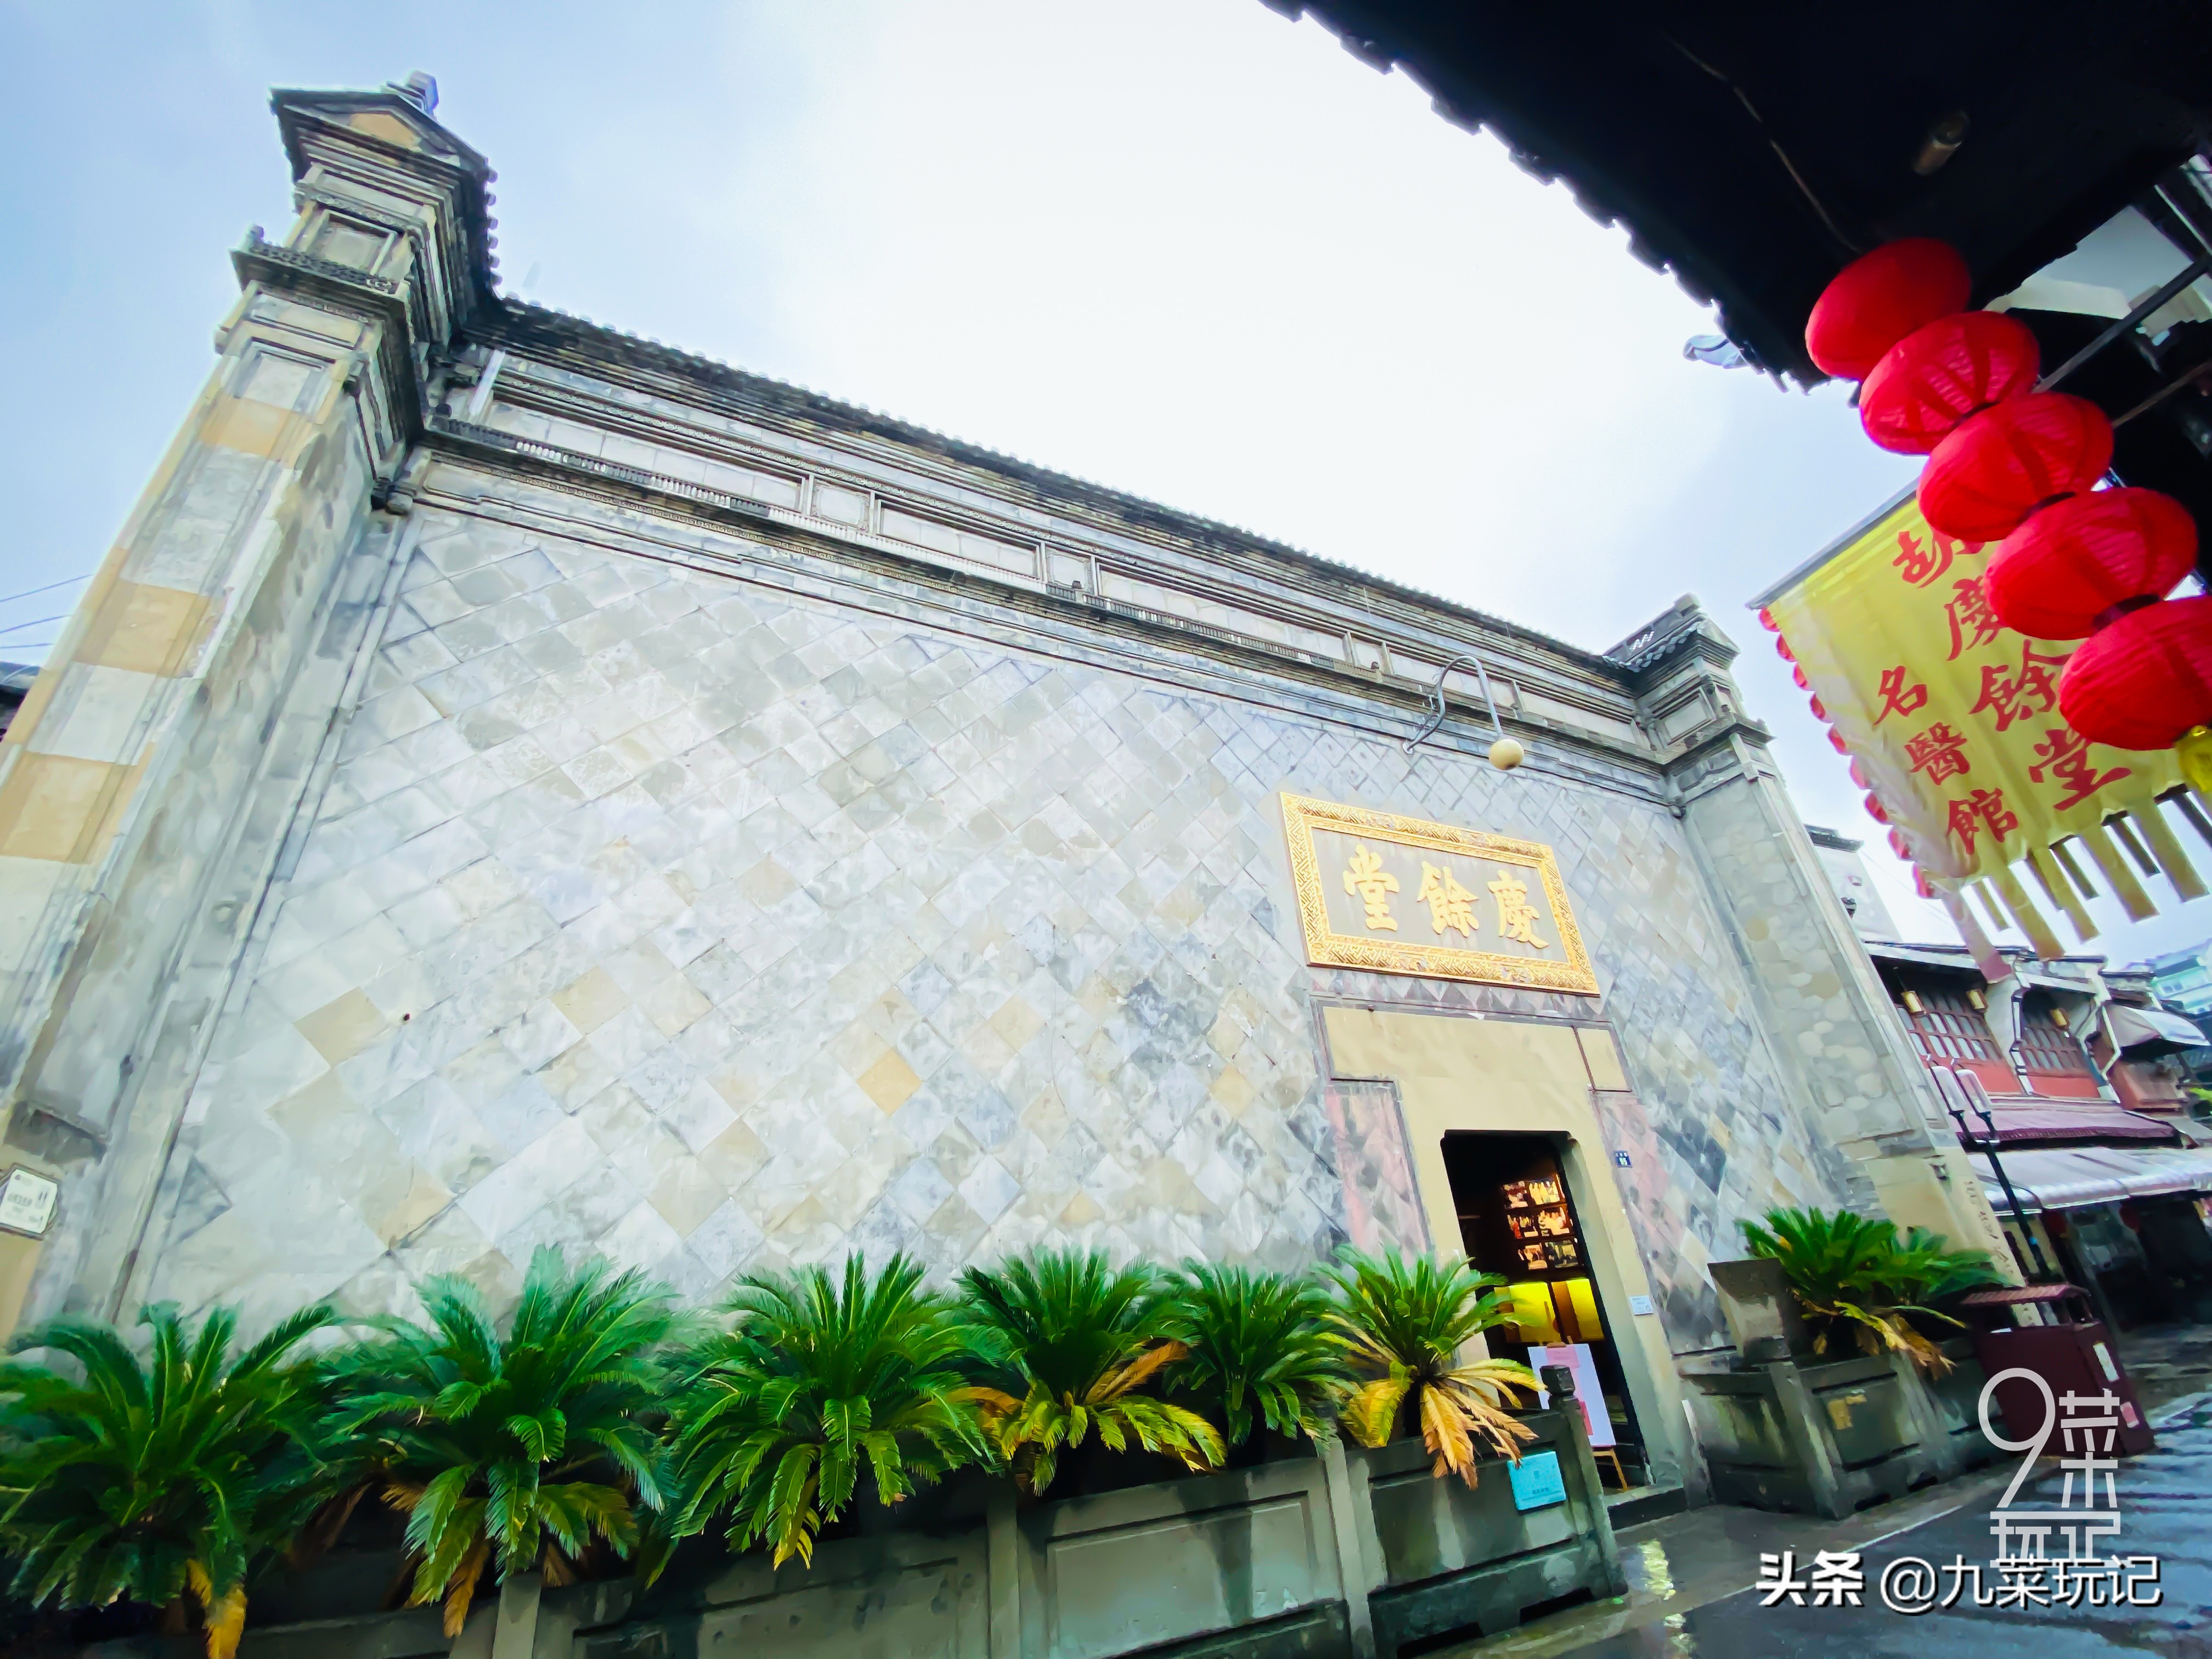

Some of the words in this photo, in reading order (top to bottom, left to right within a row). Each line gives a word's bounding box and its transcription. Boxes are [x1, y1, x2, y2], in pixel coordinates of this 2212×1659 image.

[1874, 665, 2018, 855] 名醫館
[1342, 843, 1550, 949] 慶餘堂
